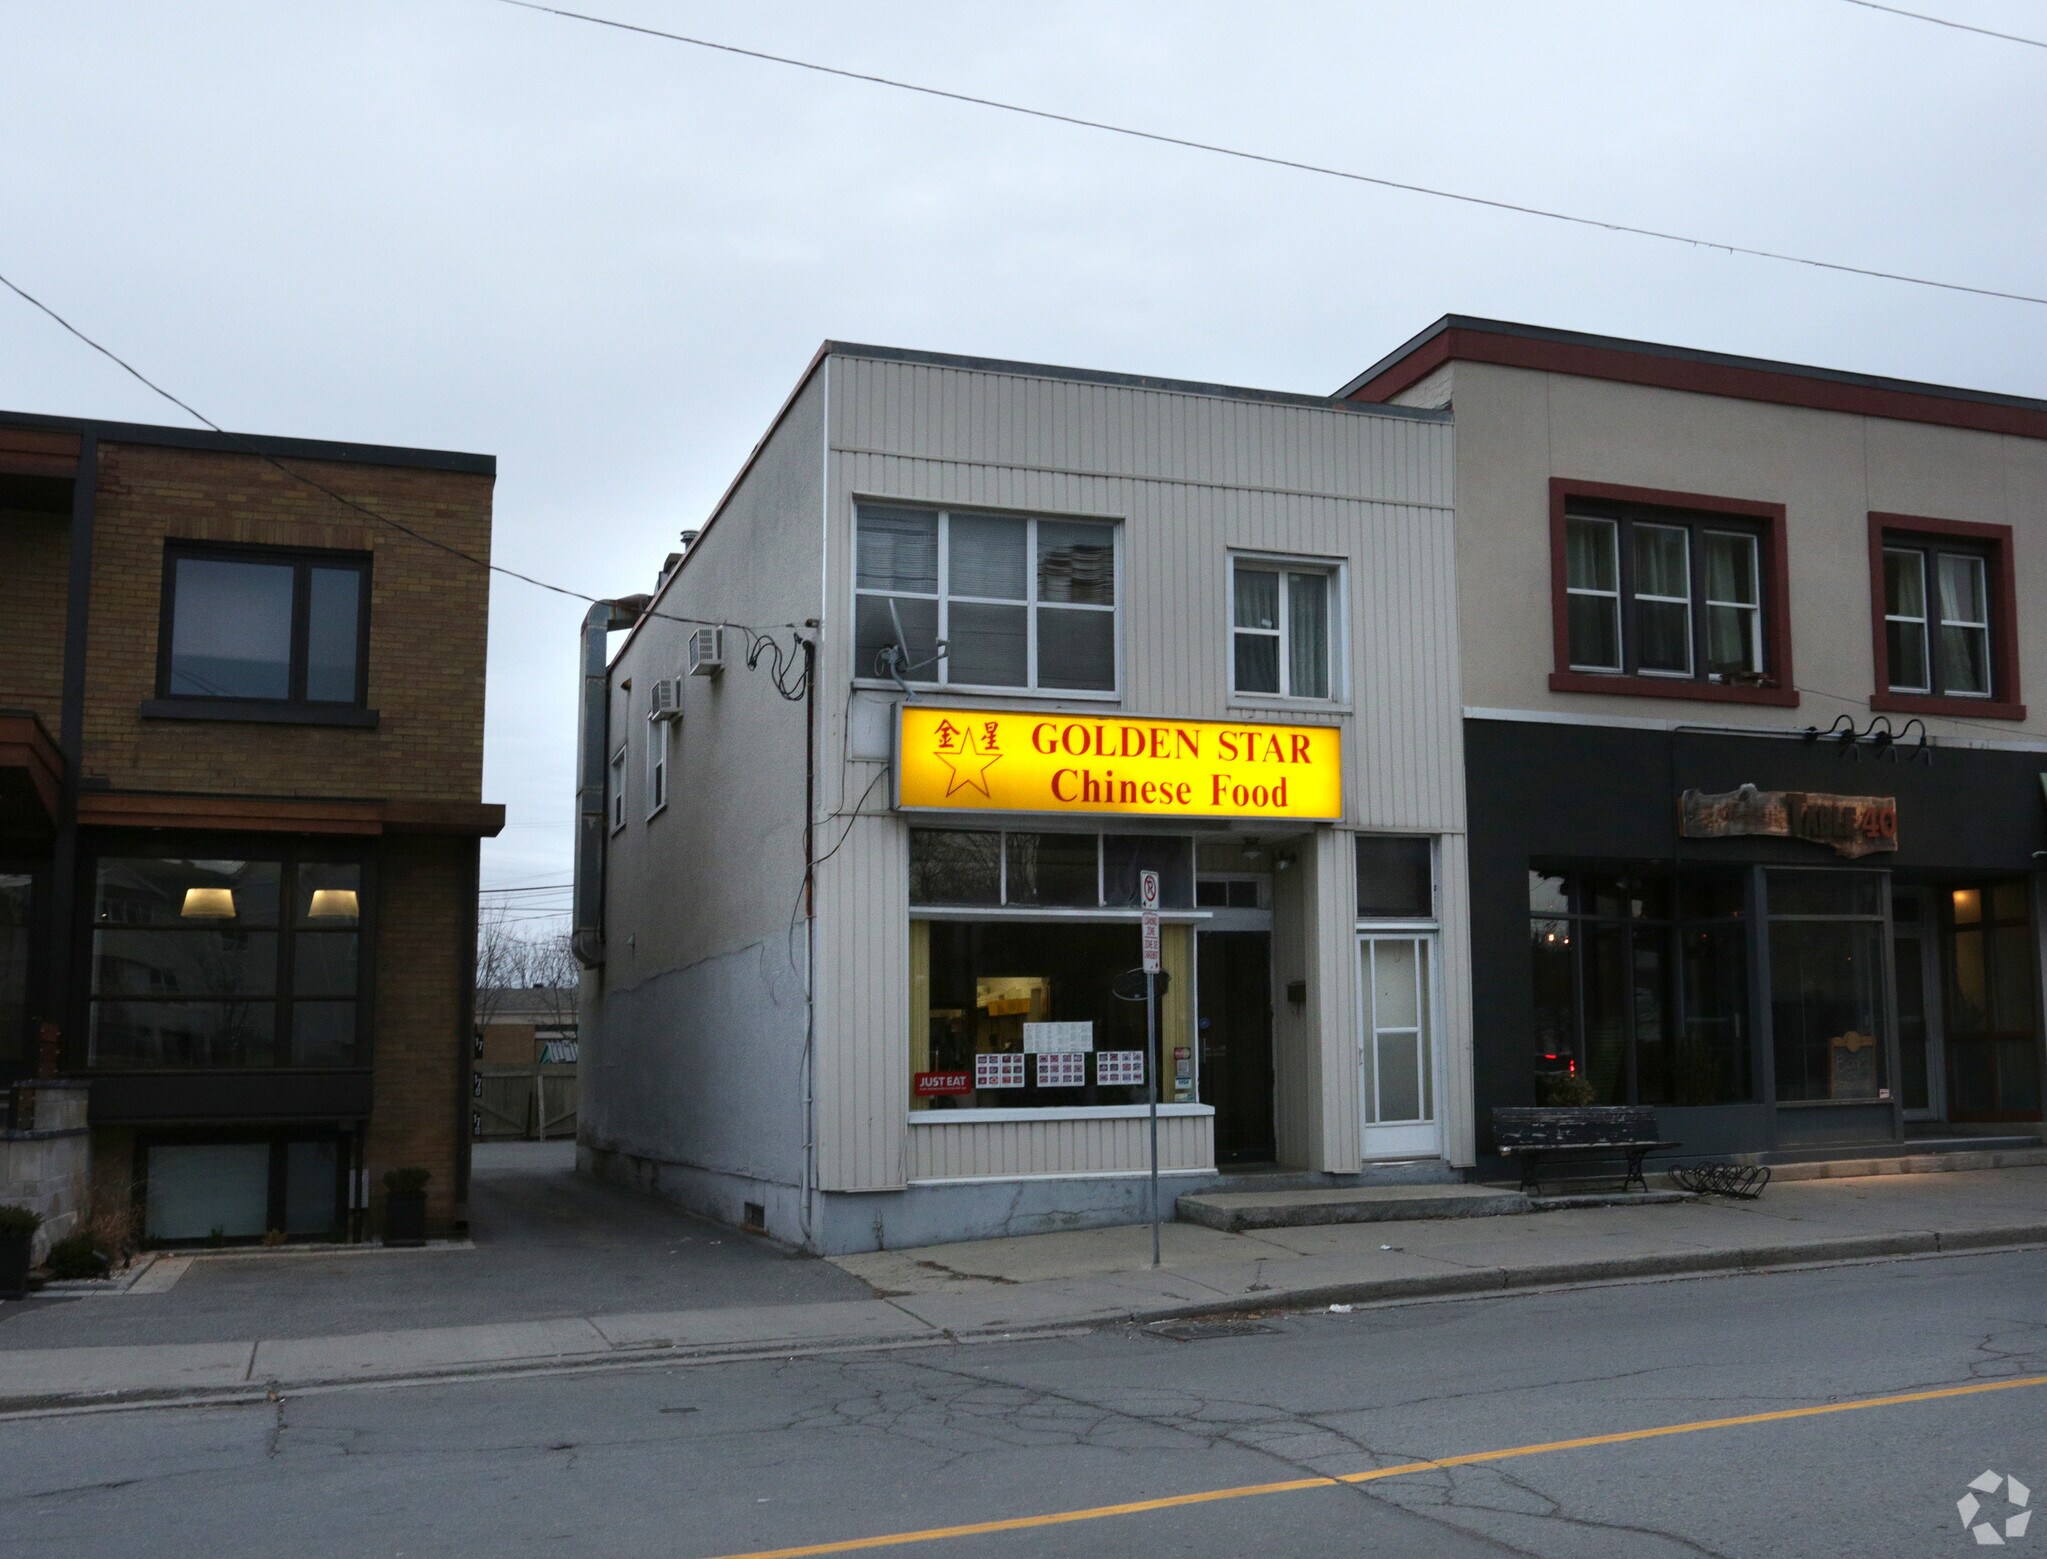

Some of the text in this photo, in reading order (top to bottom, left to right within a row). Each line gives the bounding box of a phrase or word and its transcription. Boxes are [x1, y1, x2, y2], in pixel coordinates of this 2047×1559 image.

[1031, 722, 1313, 764] GOLDEN STAR
[1051, 768, 1288, 808] Chinese Food
[1861, 807, 1897, 839] 40
[919, 1075, 967, 1087] JUST EAT
